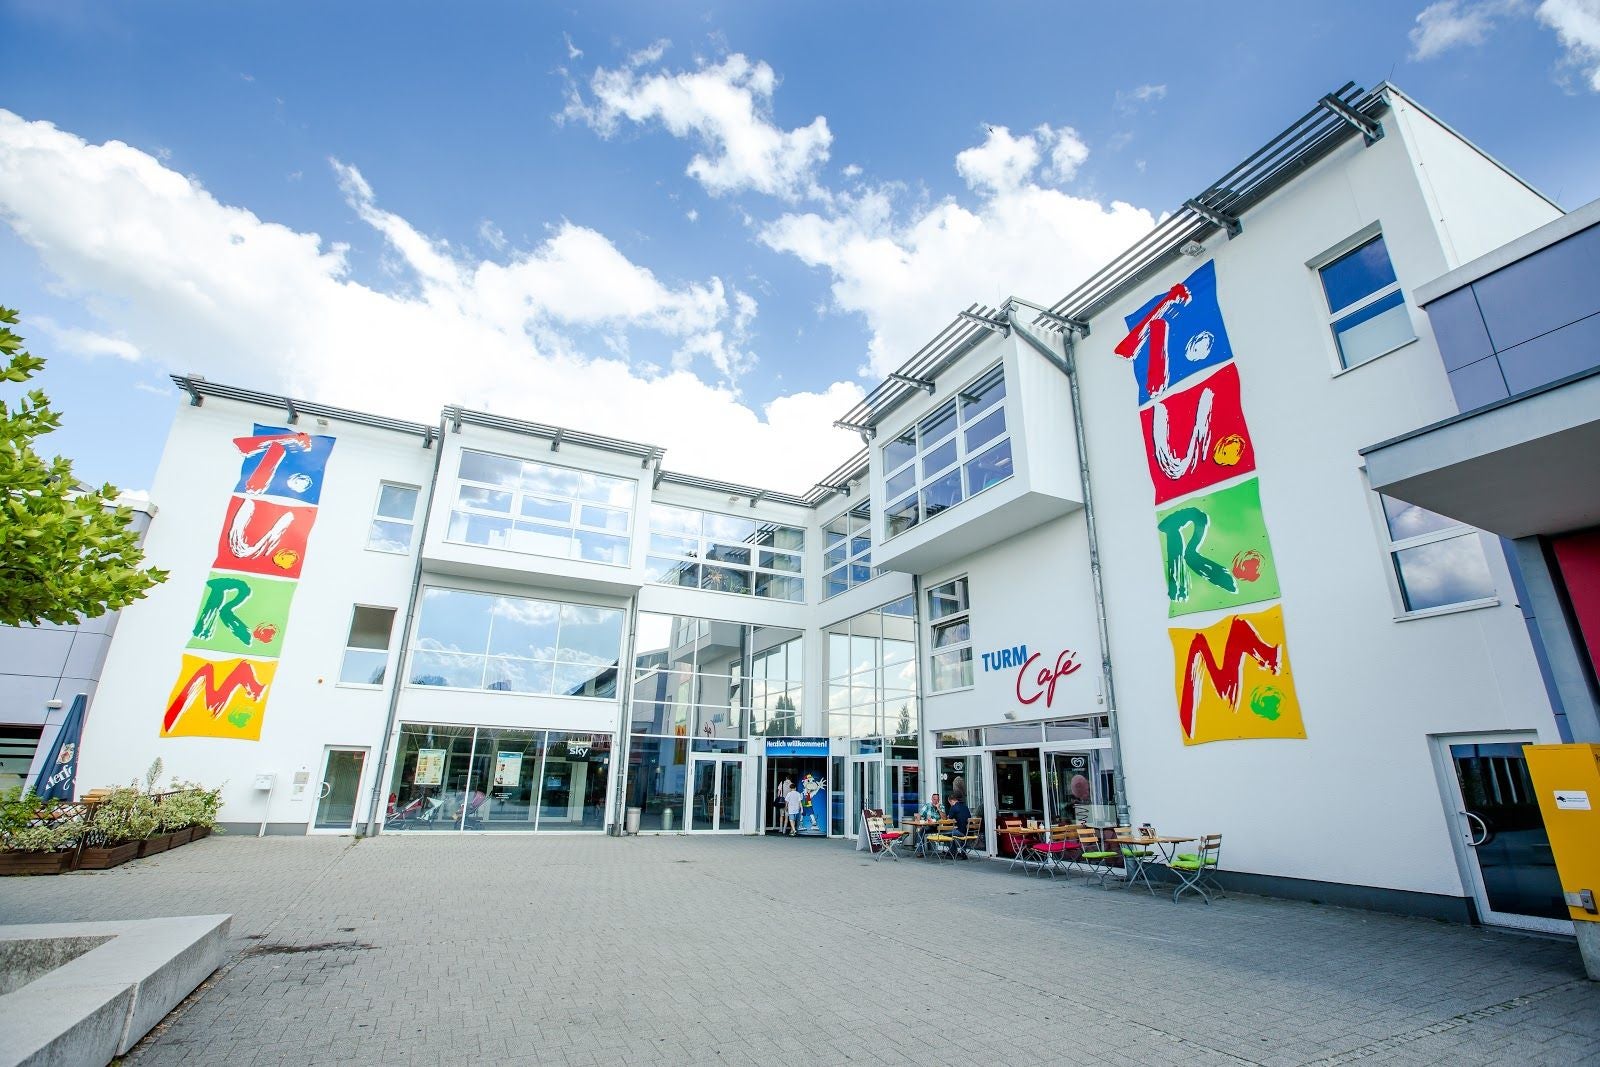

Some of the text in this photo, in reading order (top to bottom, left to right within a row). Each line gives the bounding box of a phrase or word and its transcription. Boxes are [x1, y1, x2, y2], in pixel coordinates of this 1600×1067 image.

[981, 644, 1082, 708] TURM Café
[766, 740, 786, 748] Herzlich
[569, 745, 589, 758] sky
